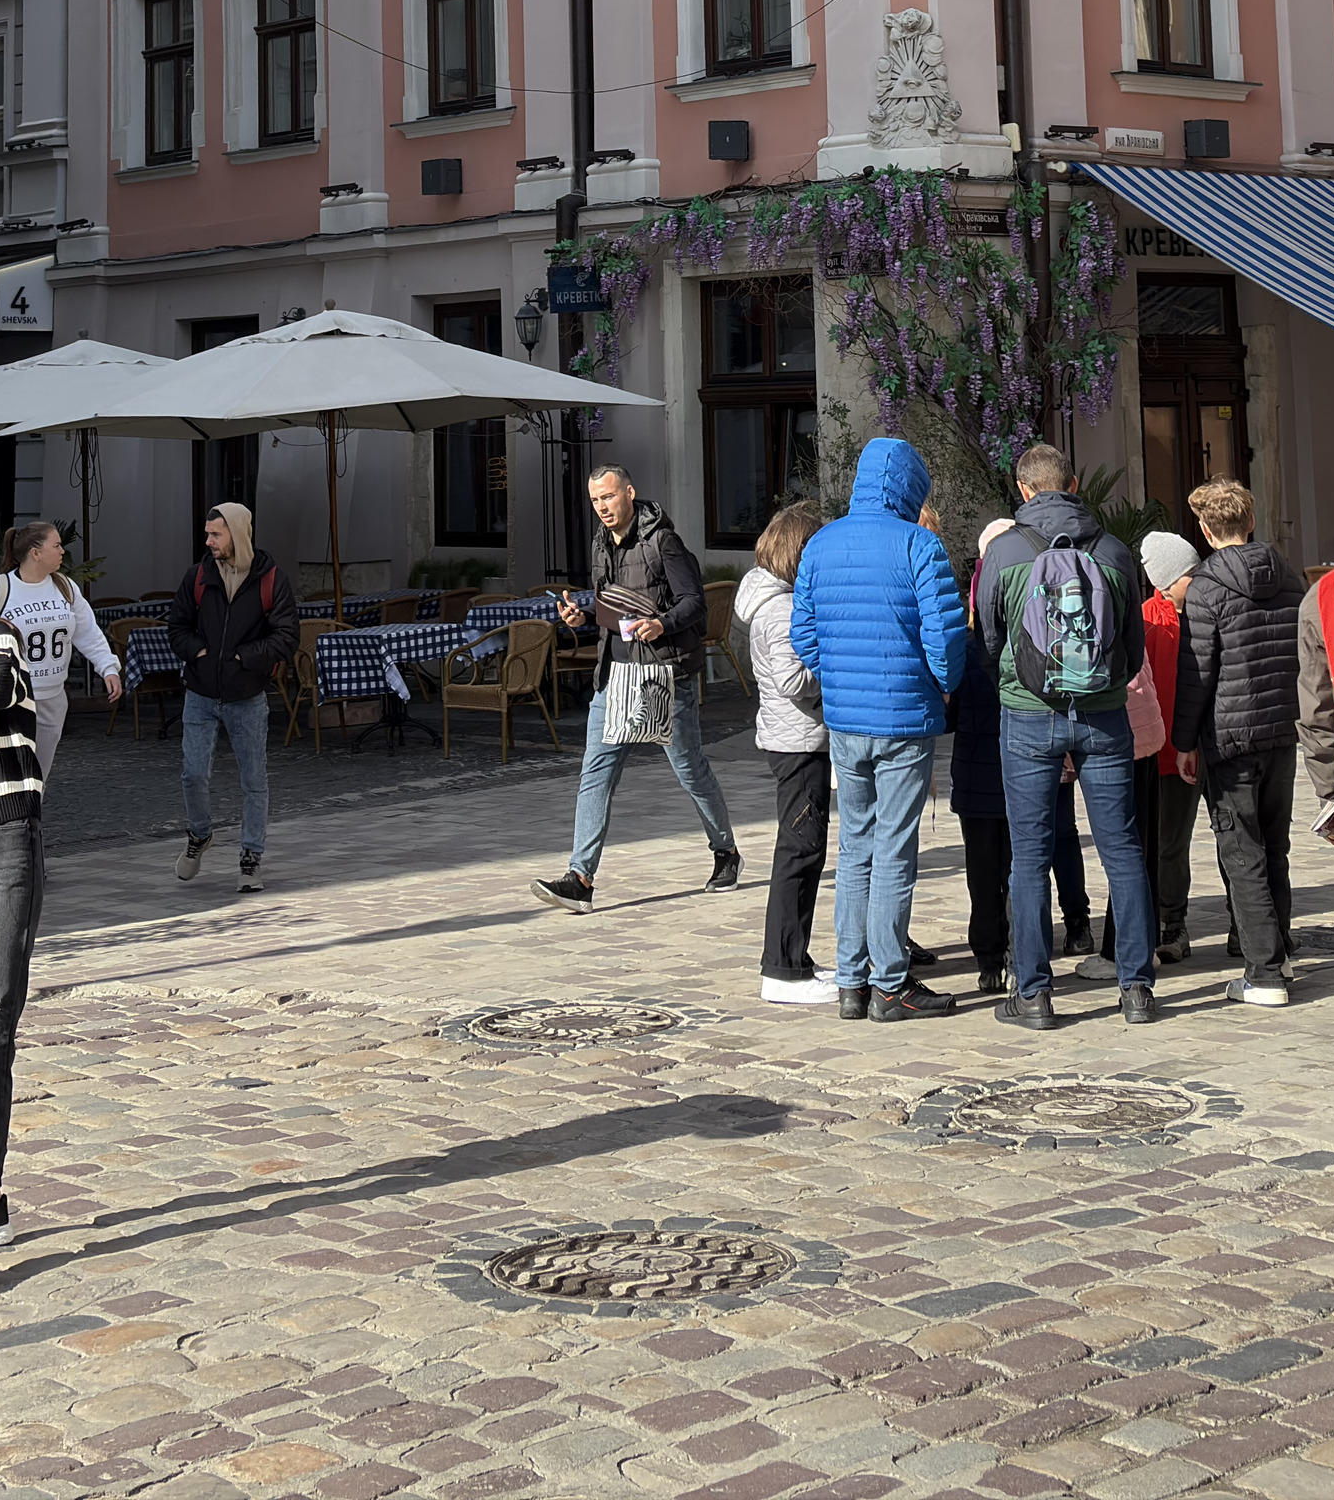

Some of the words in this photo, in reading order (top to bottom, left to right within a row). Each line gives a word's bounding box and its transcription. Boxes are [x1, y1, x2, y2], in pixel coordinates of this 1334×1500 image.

[1125, 227, 1213, 258] КРЕВЕ
[10, 286, 30, 315] 4
[556, 291, 603, 304] КРЕВЕТК
[1, 316, 37, 325] SHEVSKA
[4, 599, 69, 621] BROOKLY
[25, 617, 38, 625] NEW
[41, 615, 56, 623] YORK
[58, 613, 70, 621] CITY
[27, 628, 68, 662] 86
[52, 666, 66, 675] LEA
